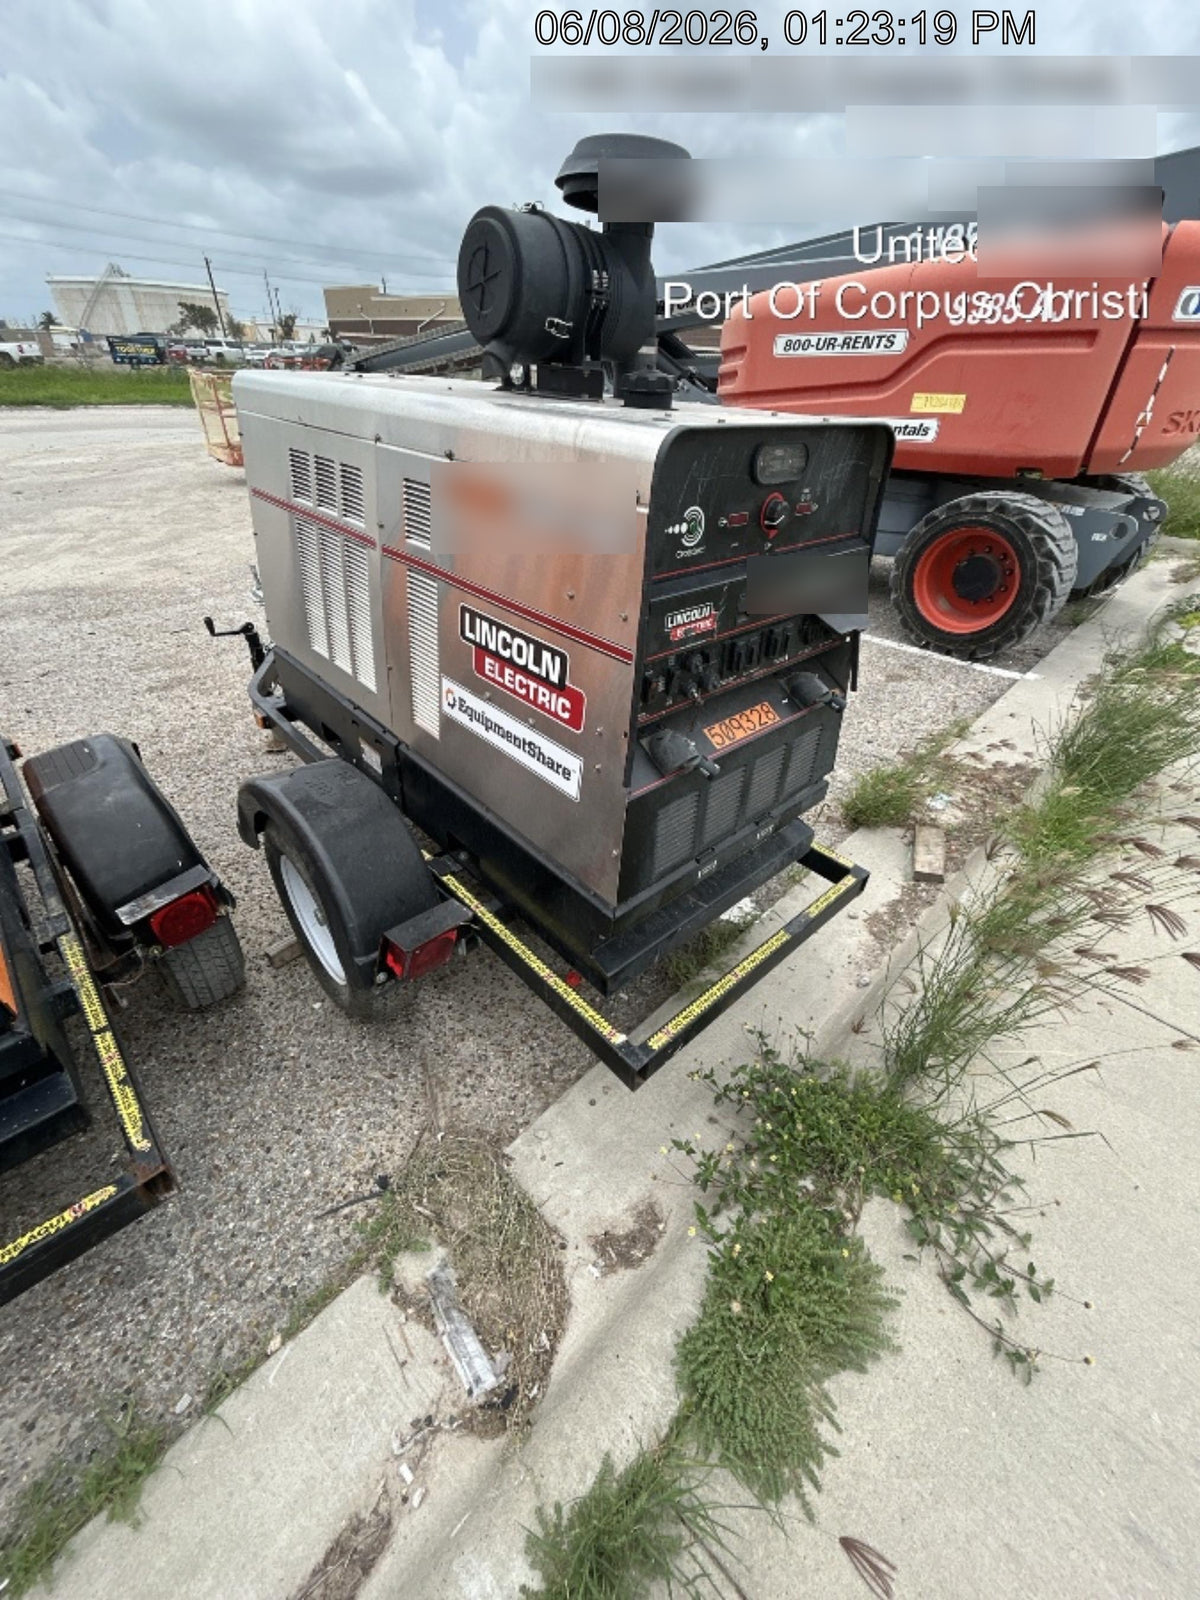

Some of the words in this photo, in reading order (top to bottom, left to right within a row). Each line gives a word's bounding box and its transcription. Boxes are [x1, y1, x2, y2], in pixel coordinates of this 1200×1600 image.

[783, 333, 897, 353] 800-UR-RENTS
[667, 605, 711, 629] LINCOLN
[464, 612, 561, 684] LINCOLN
[484, 656, 571, 720] ELECTRIC
[456, 696, 572, 781] EquipmentShare
[707, 703, 776, 746] 509328
